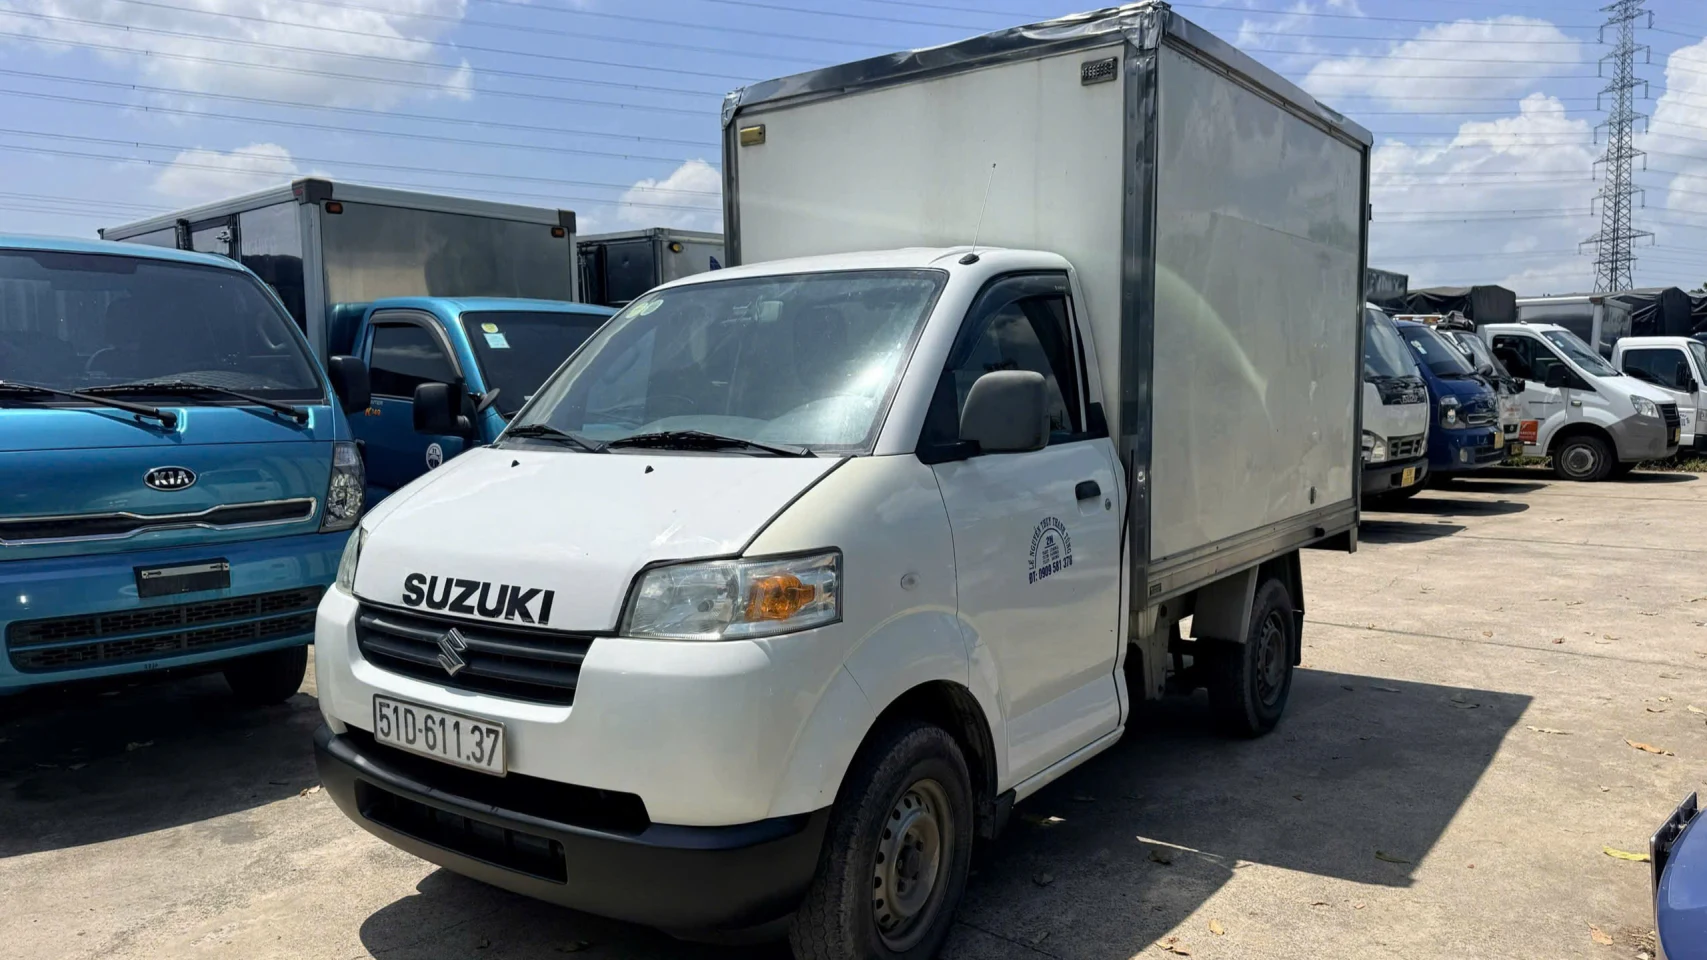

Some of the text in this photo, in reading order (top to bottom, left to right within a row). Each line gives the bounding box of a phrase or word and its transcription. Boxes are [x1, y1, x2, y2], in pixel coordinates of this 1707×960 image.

[153, 470, 190, 486] KIA
[1038, 563, 1052, 580] 0909
[1052, 559, 1062, 573] 581
[402, 572, 556, 626] SUZUKI
[377, 700, 501, 767] 51D-611.37
